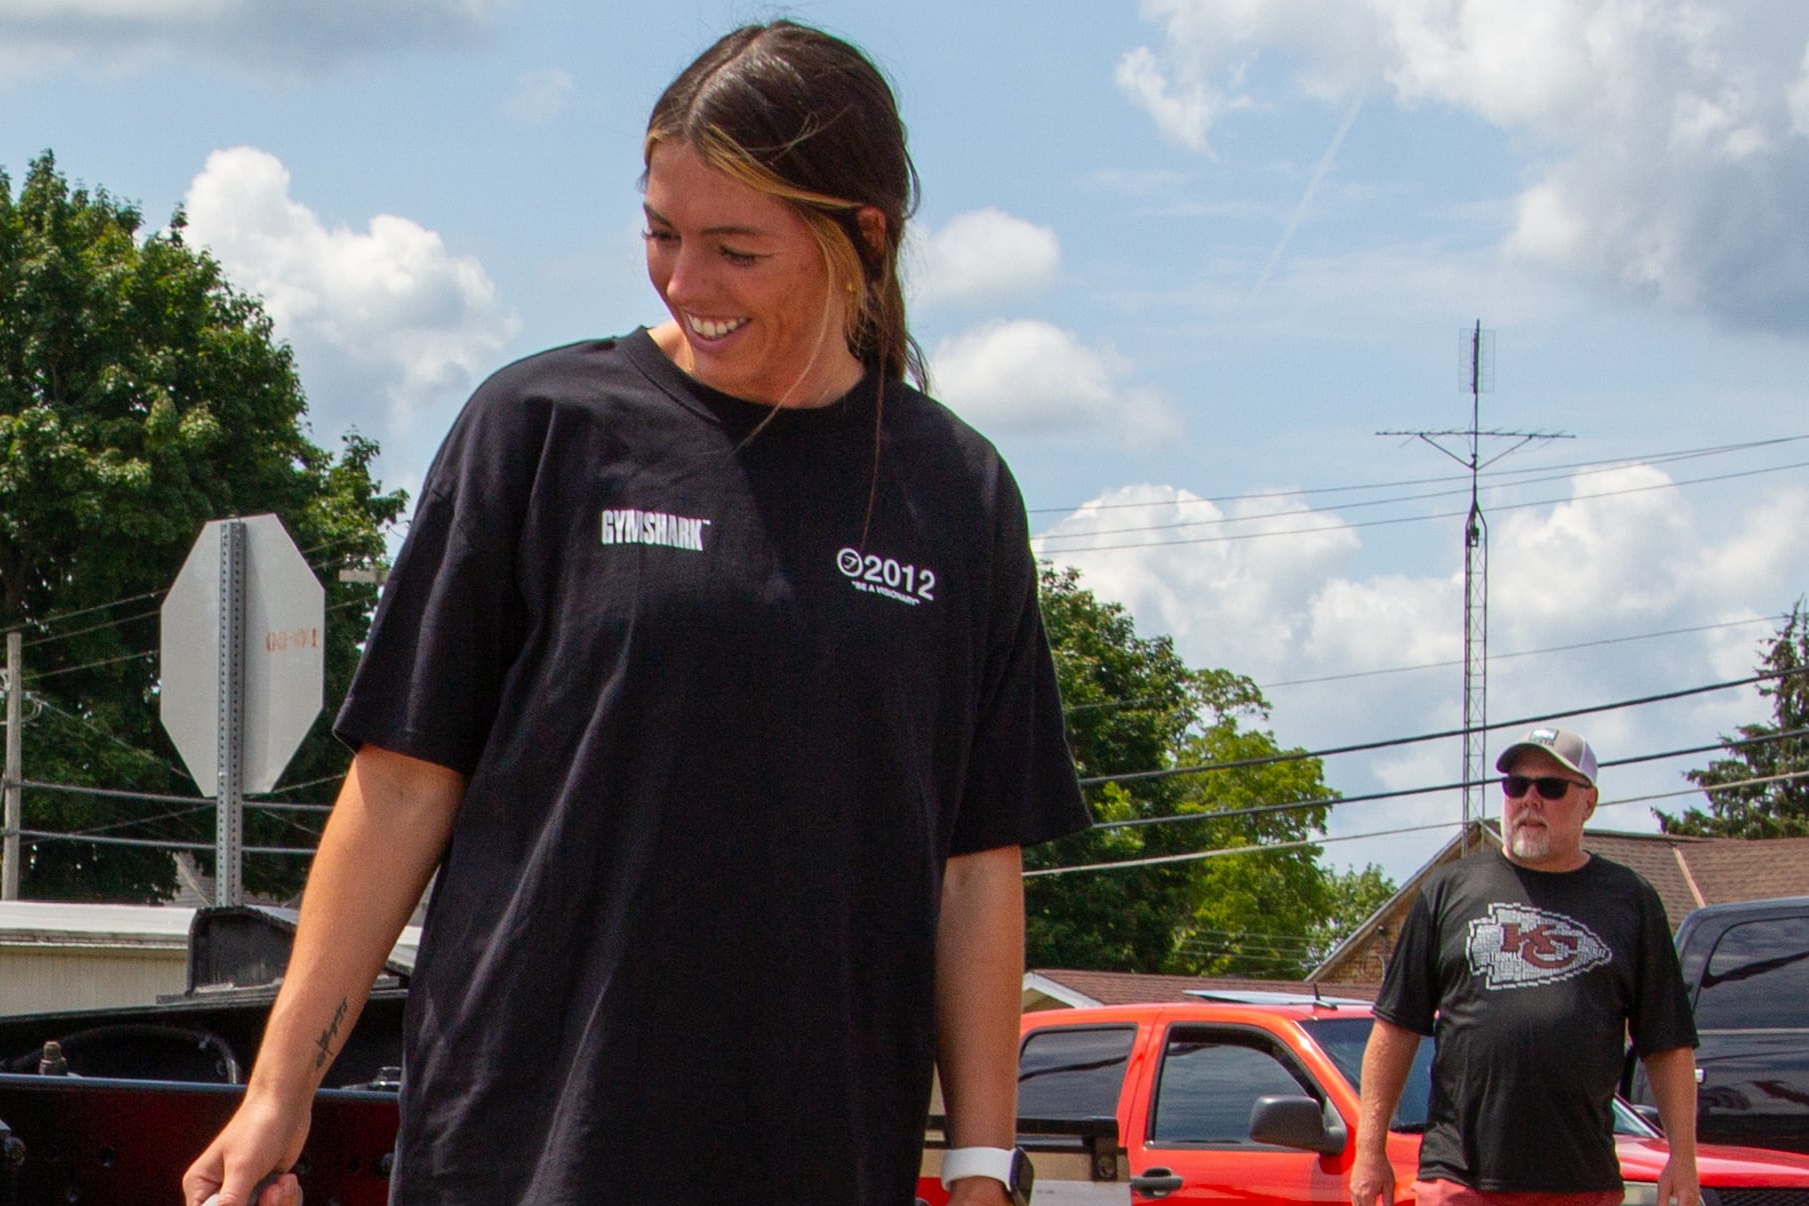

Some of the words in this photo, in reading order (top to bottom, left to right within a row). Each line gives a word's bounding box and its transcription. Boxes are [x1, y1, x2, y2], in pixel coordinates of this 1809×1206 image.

[601, 508, 704, 552] GYMSHARK
[863, 554, 936, 601] 2012
[1490, 951, 1523, 963] THOMAS
